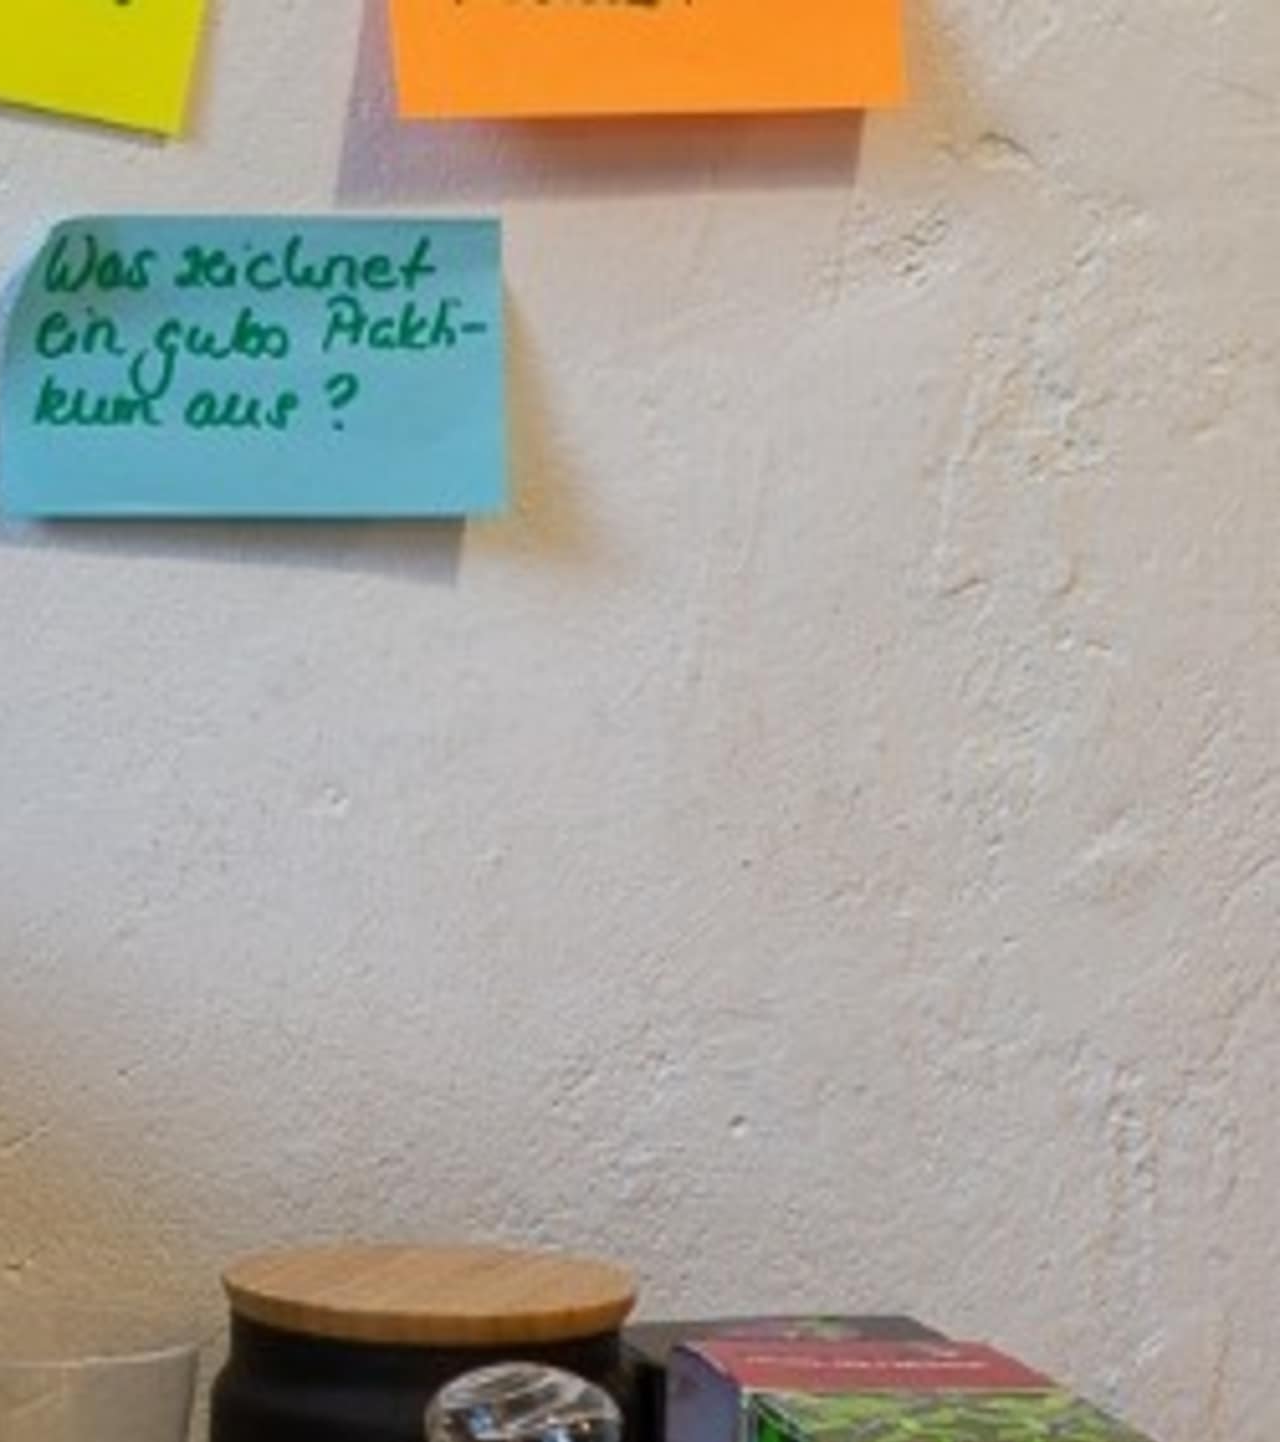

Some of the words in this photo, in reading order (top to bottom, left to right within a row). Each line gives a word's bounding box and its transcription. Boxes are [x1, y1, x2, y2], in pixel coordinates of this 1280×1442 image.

[45, 233, 157, 293] Was
[174, 235, 438, 292] zeichnet
[34, 306, 126, 360] ein
[34, 372, 162, 428] kum
